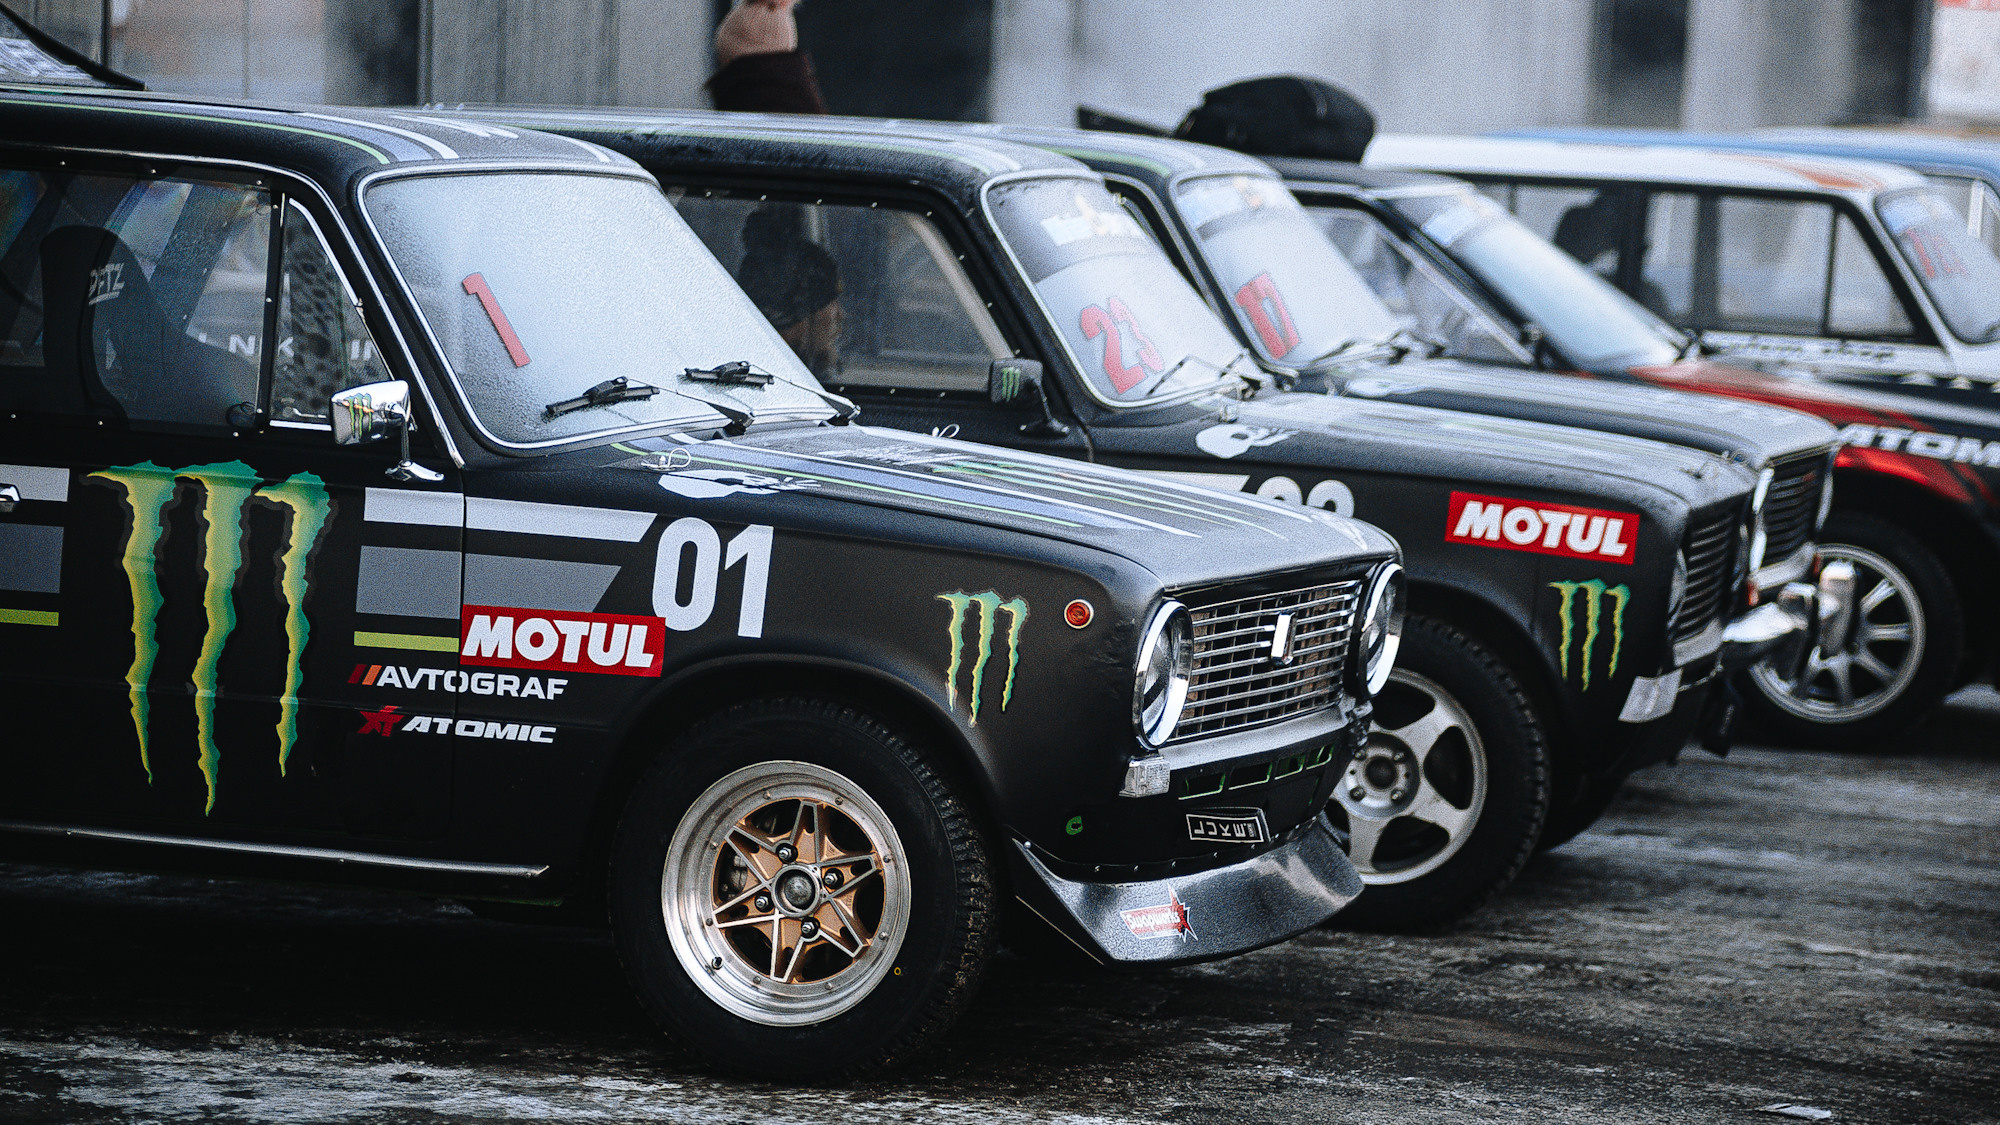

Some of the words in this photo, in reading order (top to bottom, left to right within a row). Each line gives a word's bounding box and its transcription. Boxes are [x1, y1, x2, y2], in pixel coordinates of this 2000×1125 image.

[462, 272, 532, 368] 1
[1081, 297, 1165, 394] 23
[1453, 500, 1628, 557] MOTUL
[652, 516, 774, 638] 01
[462, 614, 655, 668] MOTUL
[376, 665, 569, 701] AVTOGRAF
[402, 715, 557, 744] ATOMIC
